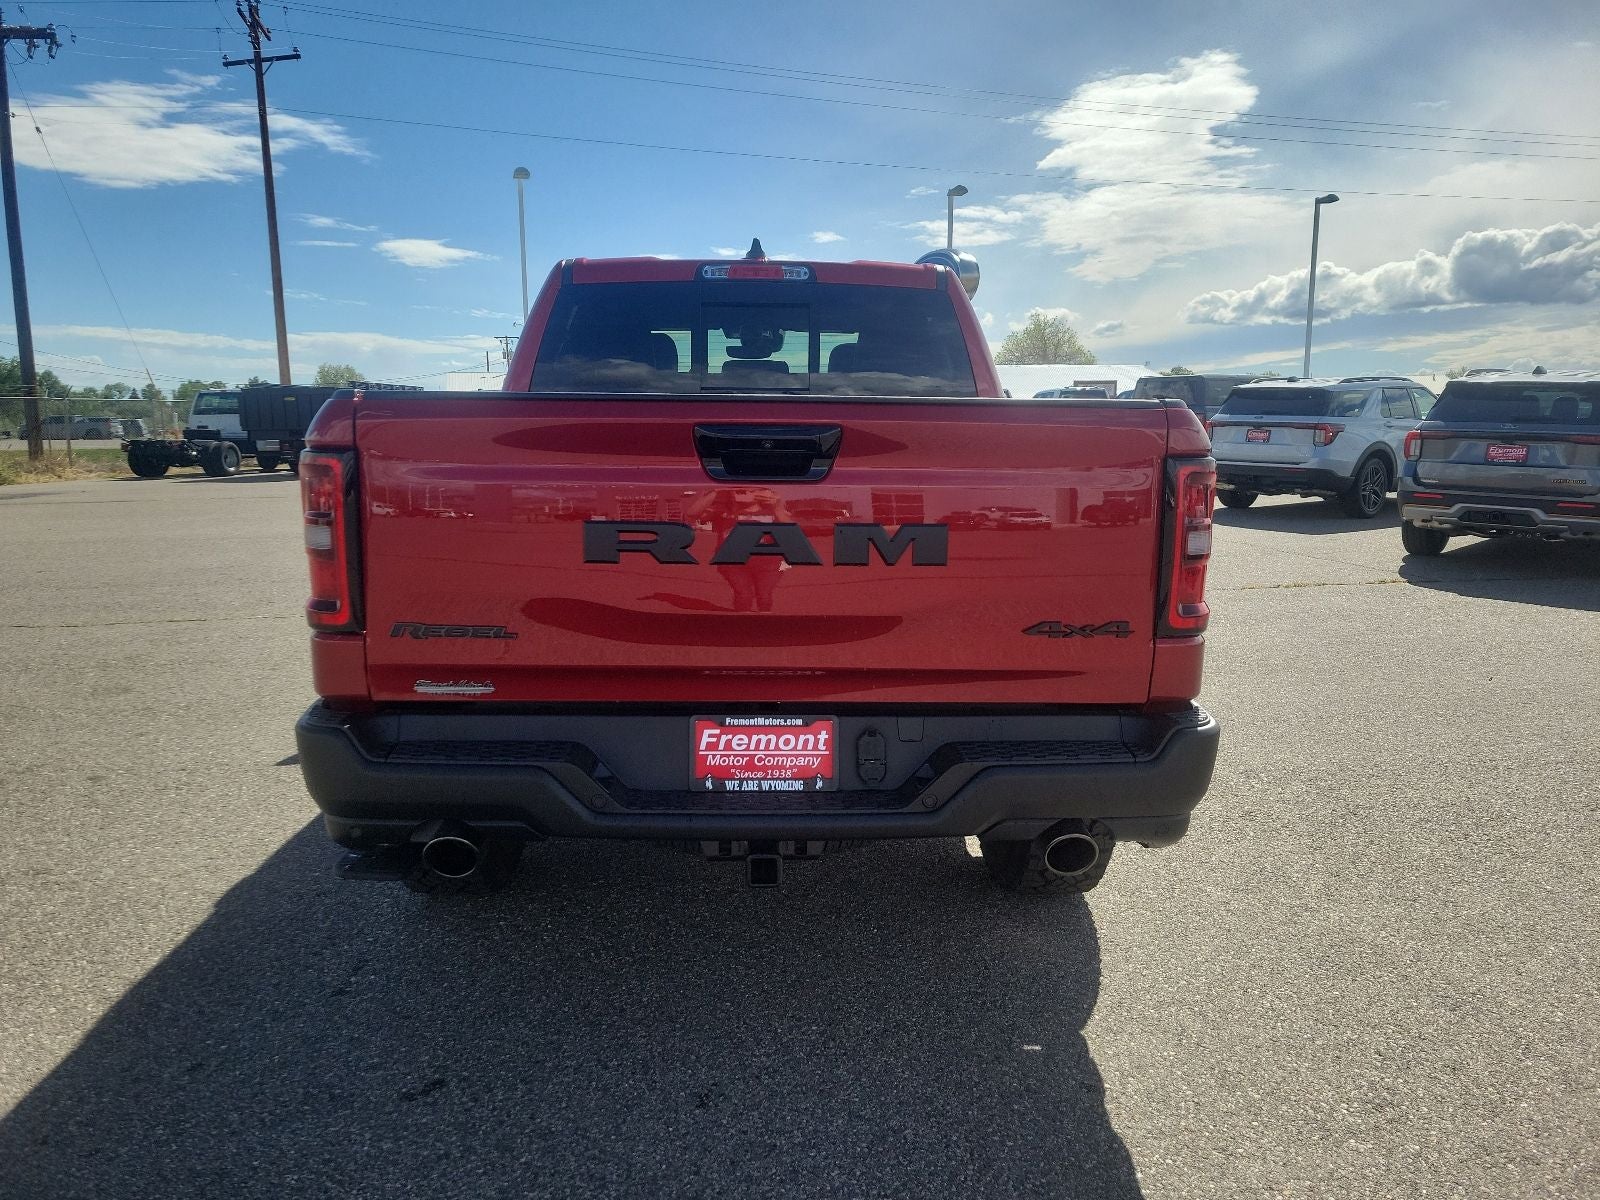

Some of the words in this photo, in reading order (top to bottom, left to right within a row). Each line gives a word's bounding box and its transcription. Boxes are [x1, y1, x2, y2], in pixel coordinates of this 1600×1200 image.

[583, 520, 949, 567] RAM
[1021, 620, 1136, 638] 4x4
[725, 717, 803, 726] FremontMotors.com
[700, 729, 829, 751] Fremont
[706, 754, 749, 766] Motor
[754, 754, 821, 768] Company
[725, 780, 740, 791] WE
[741, 780, 759, 791] ARE
[761, 780, 804, 791] WYOMING
